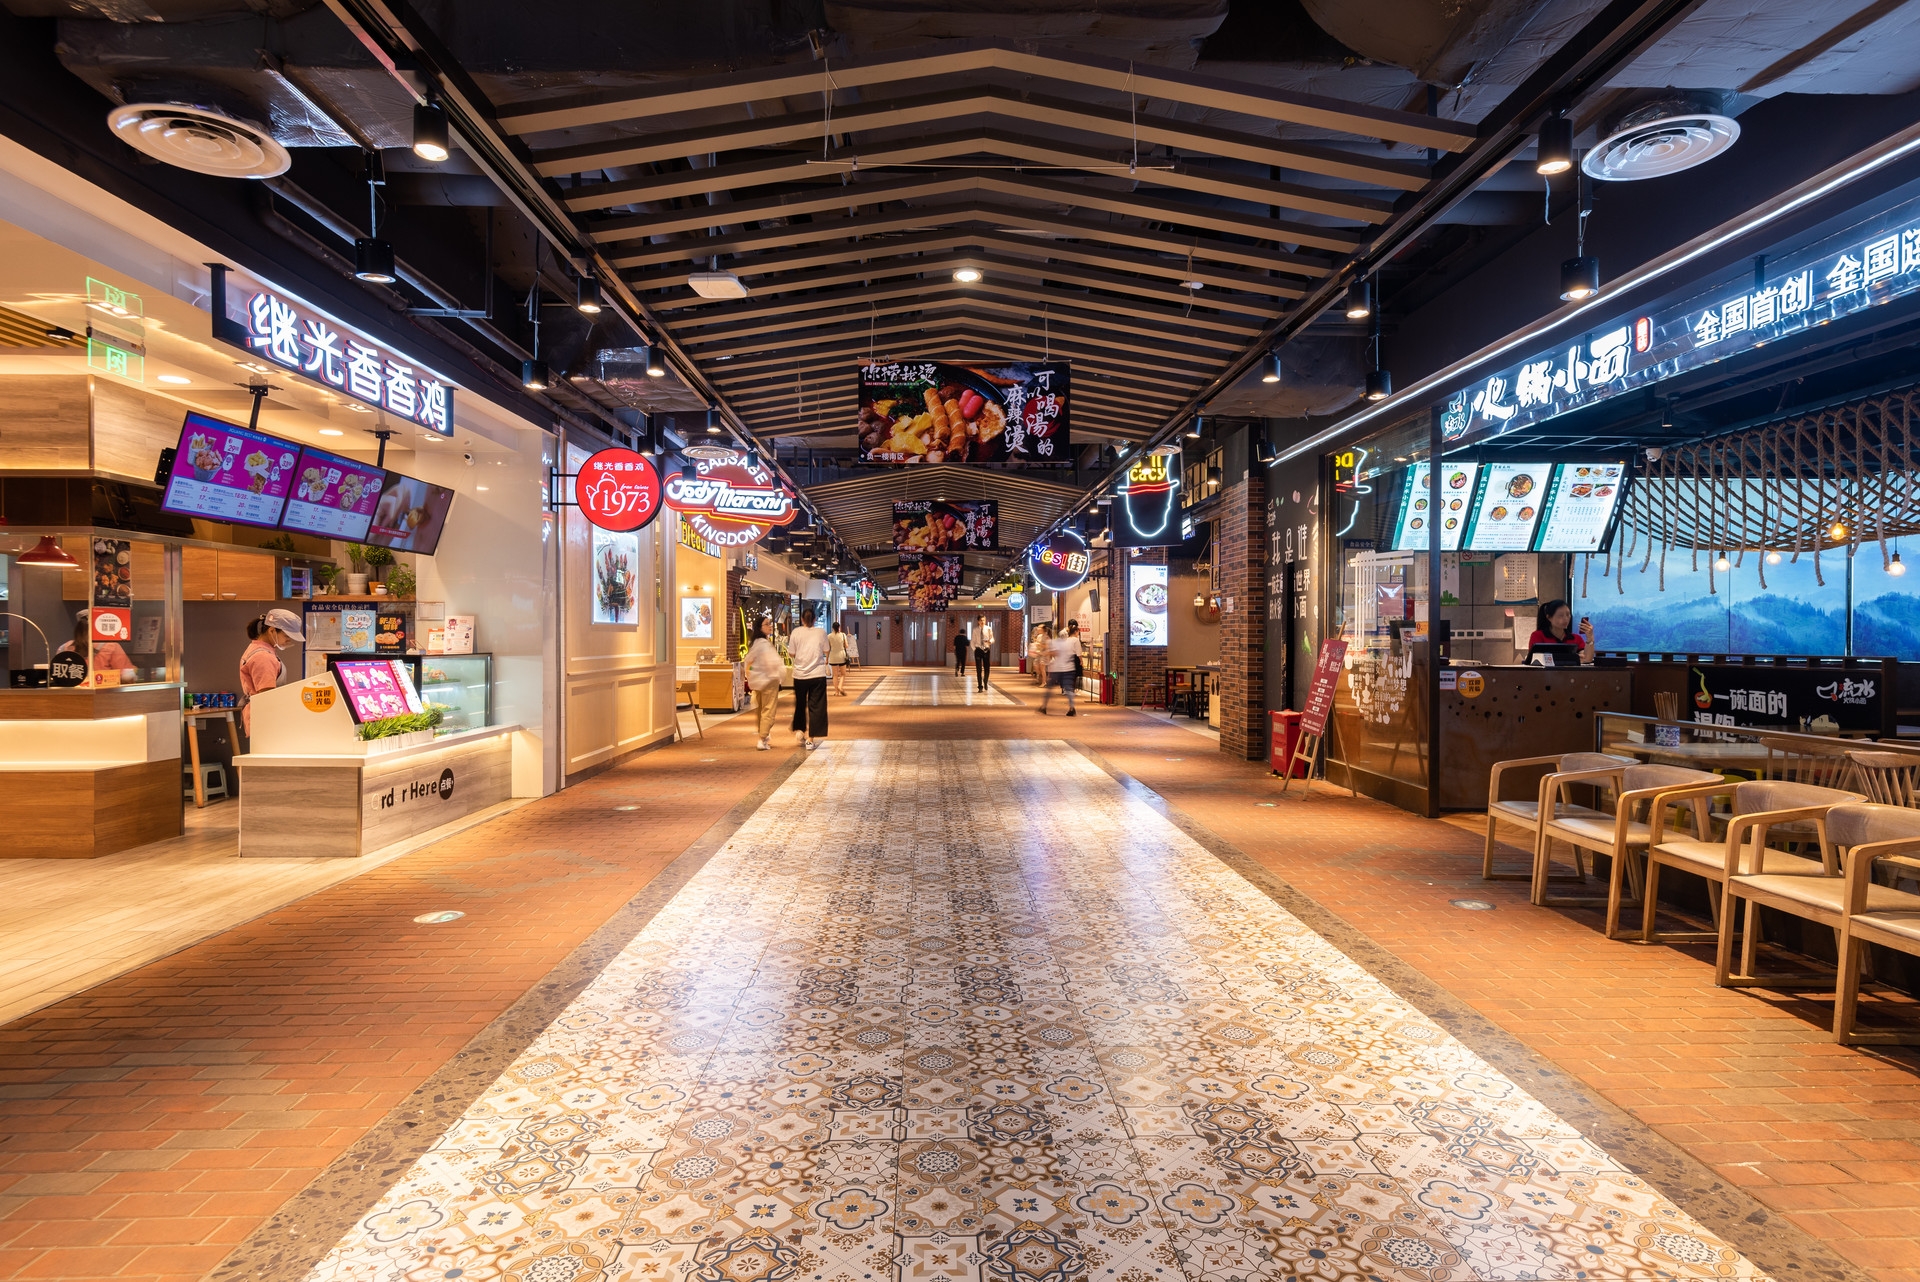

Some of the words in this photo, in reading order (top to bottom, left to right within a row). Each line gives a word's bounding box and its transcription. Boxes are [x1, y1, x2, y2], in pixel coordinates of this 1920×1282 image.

[1694, 269, 1813, 348] 全国首创
[248, 293, 446, 431] 继光香香鸡
[1474, 326, 1631, 420] 火锅小面
[593, 462, 645, 472] 继光香香鸡
[601, 490, 650, 516] 1973
[666, 480, 718, 504] Jody
[691, 514, 761, 546] KINGDOM
[1271, 524, 1308, 566] 我是谁
[1035, 544, 1088, 574] Yes!街
[52, 662, 84, 679] 取餐
[315, 697, 331, 705] 光临
[1713, 688, 1788, 719] 一碗面的
[410, 781, 437, 800] Here
